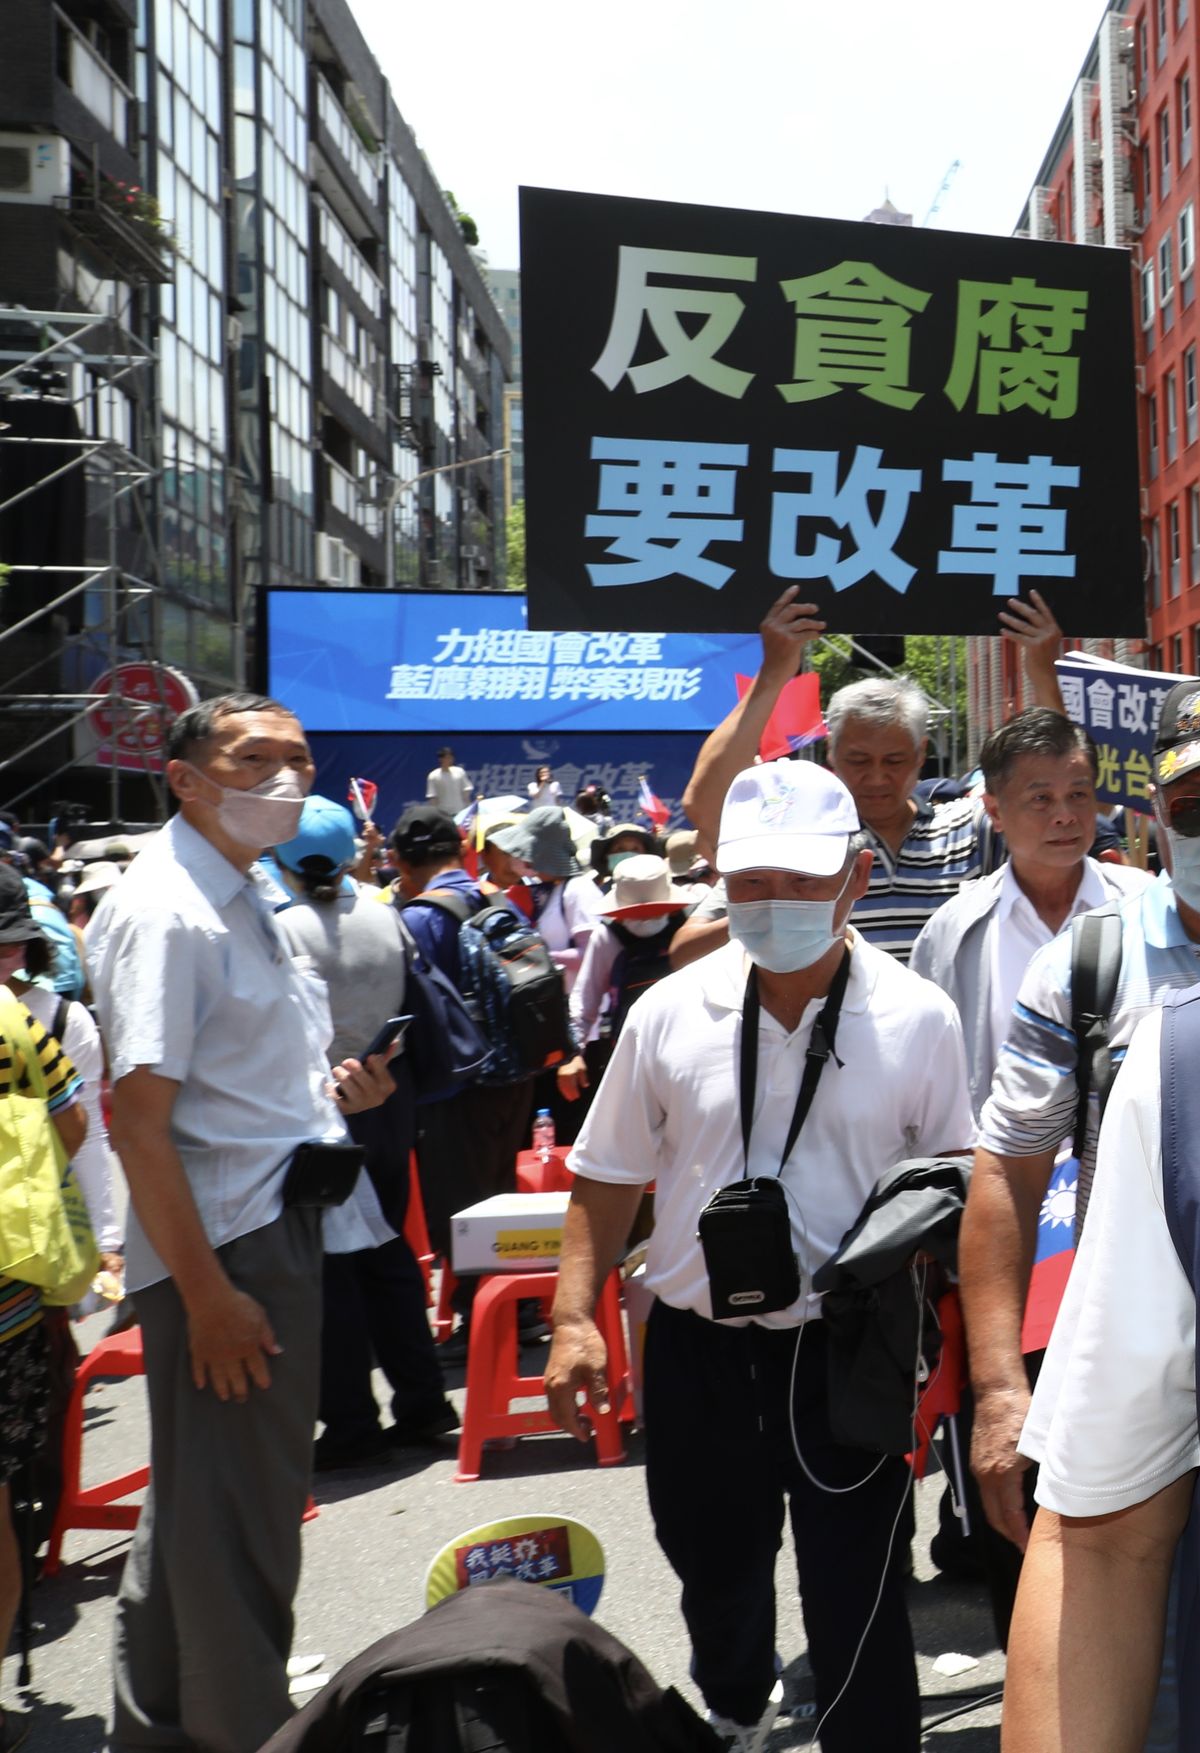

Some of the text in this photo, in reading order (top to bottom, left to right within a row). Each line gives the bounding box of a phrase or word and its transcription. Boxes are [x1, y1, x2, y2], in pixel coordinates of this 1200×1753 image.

[591, 245, 1089, 419] 反貪腐
[584, 436, 1081, 596] 要改革
[432, 628, 666, 665] 力挺國會改革
